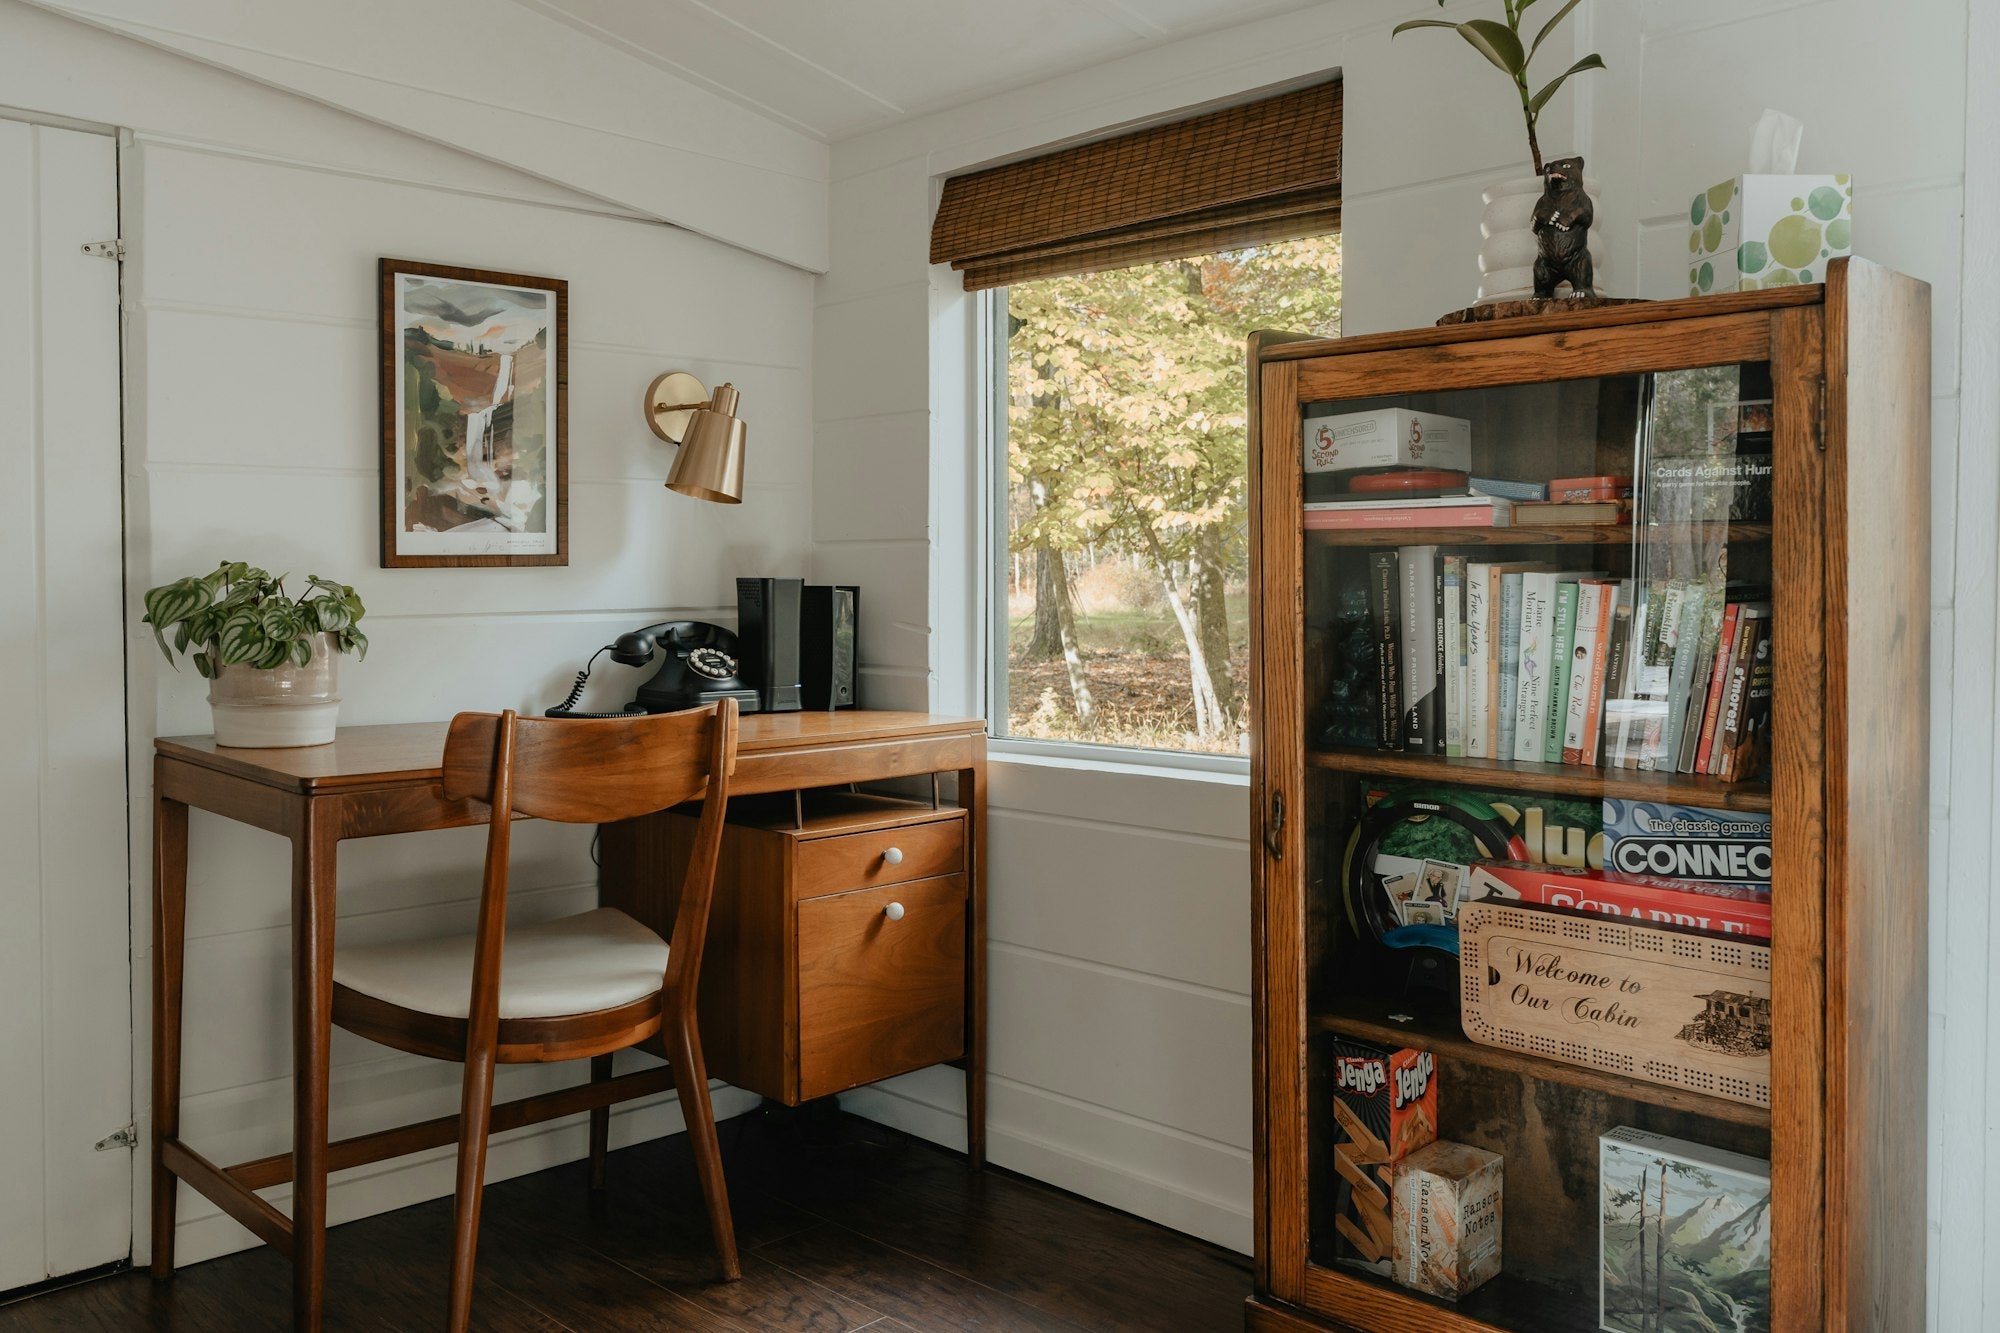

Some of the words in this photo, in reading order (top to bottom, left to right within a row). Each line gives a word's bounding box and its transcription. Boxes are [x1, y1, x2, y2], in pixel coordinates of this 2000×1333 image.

[1317, 427, 1333, 450] 5
[1411, 420, 1422, 443] 5
[1312, 449, 1338, 461] SECOND
[1408, 440, 1425, 452] SECOND
[1411, 451, 1423, 460] RULE
[1316, 458, 1334, 468] RULE
[1656, 466, 1692, 478] Cards
[1694, 465, 1742, 479] Against
[1470, 580, 1481, 589] In
[1470, 593, 1483, 616] Five
[1558, 590, 1569, 604] I'M
[1522, 591, 1536, 632] Moriarty
[1536, 600, 1546, 627] Liane
[1556, 606, 1567, 632] STILL
[1466, 621, 1481, 655] Years
[1554, 635, 1565, 661] HERE
[1387, 642, 1395, 665] Women
[1531, 675, 1540, 697] Nine
[1553, 665, 1561, 686] AUSTIN
[1573, 674, 1584, 691] The
[1589, 642, 1603, 714] woodswoman
[1389, 693, 1397, 708] With
[1518, 680, 1531, 722] Strangers
[1551, 687, 1559, 717] CHANNING
[1708, 698, 1719, 718] WORLD
[1725, 666, 1746, 733] s'mores!
[1529, 700, 1539, 730] Perfect
[1704, 717, 1715, 740] HISTORY
[1413, 802, 1440, 811] simon
[1650, 819, 1672, 832] The
[1674, 820, 1718, 832] classic
[1721, 822, 1755, 834] game
[1507, 946, 1613, 988] Welcome
[1619, 975, 1646, 994] to
[1511, 983, 1553, 1010] Our
[1561, 997, 1641, 1031] Cabin
[1338, 1059, 1386, 1094] Jenga
[1395, 1052, 1434, 1108] Jenga
[1421, 1179, 1431, 1234] Ransom
[1463, 1190, 1500, 1221] Ransom
[1464, 1211, 1495, 1238] Notes
